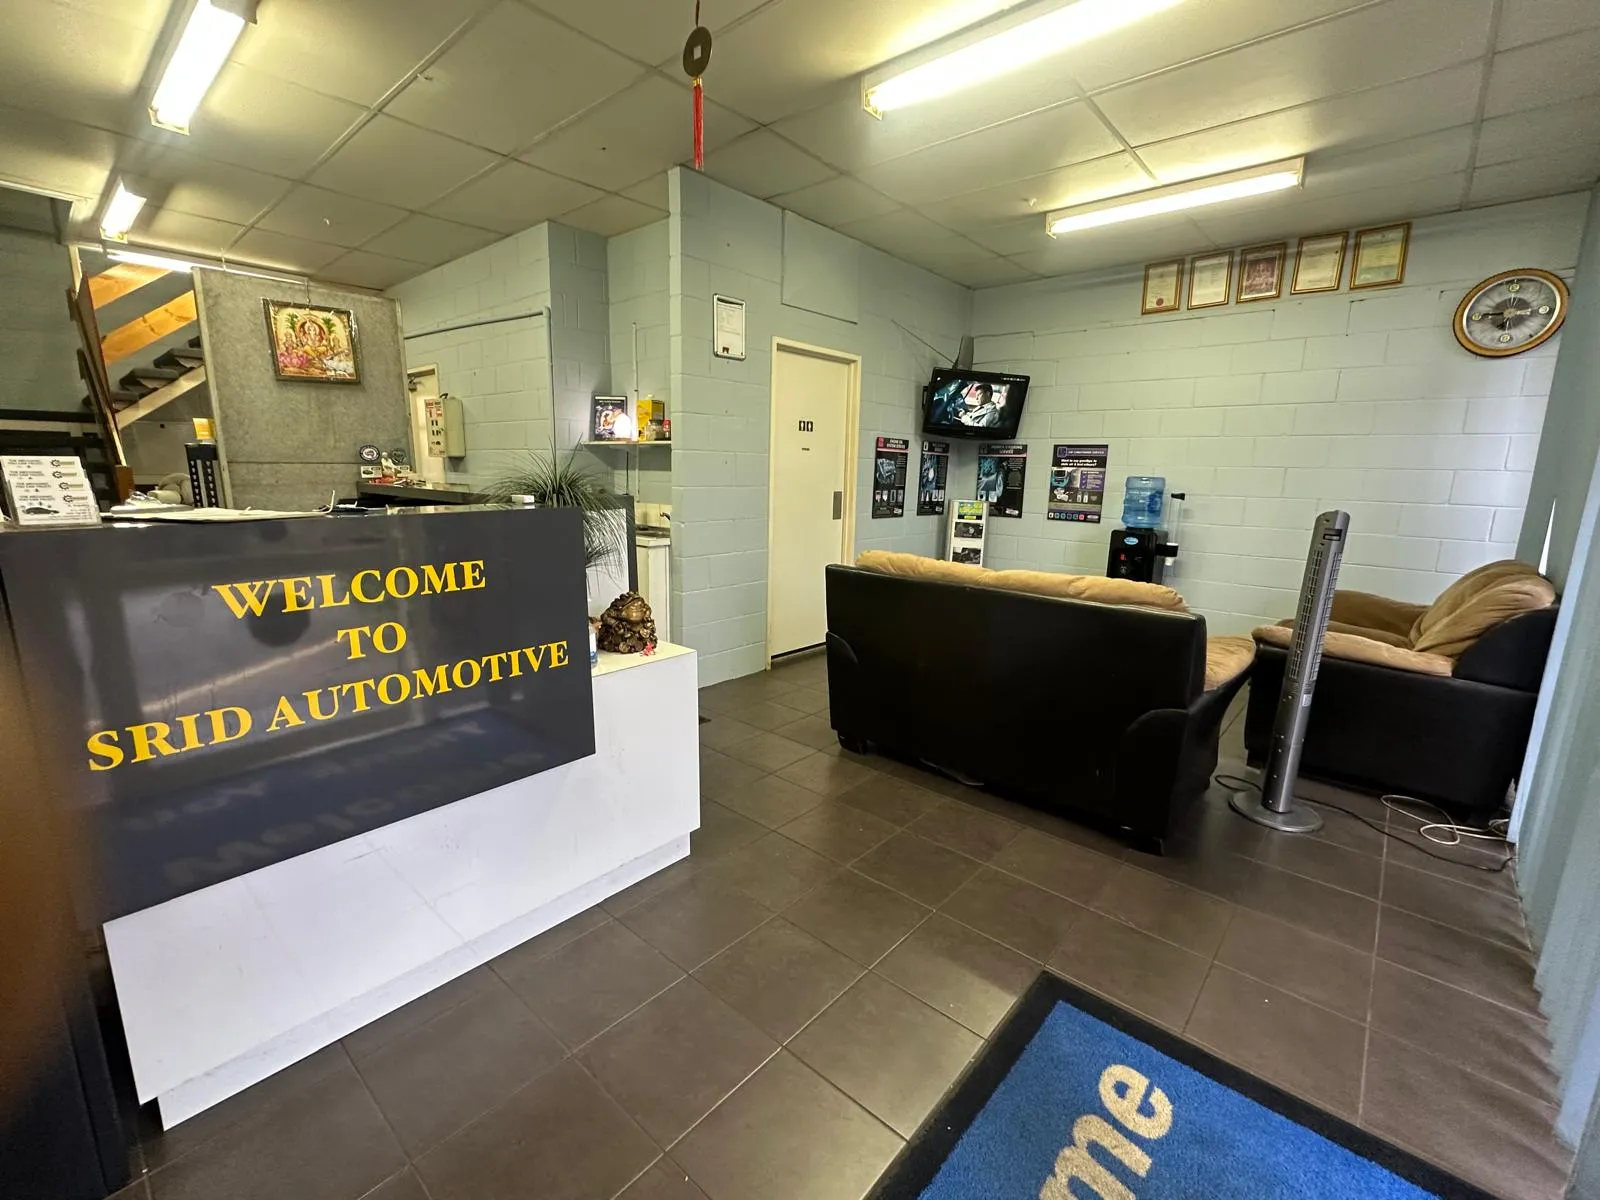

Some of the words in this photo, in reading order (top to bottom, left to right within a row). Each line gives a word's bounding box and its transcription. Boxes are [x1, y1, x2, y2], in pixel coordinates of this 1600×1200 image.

[212, 559, 486, 619] WELCOME
[336, 621, 407, 660] TO
[87, 704, 254, 772] SRID
[266, 640, 569, 733] AUTOMOTIVE
